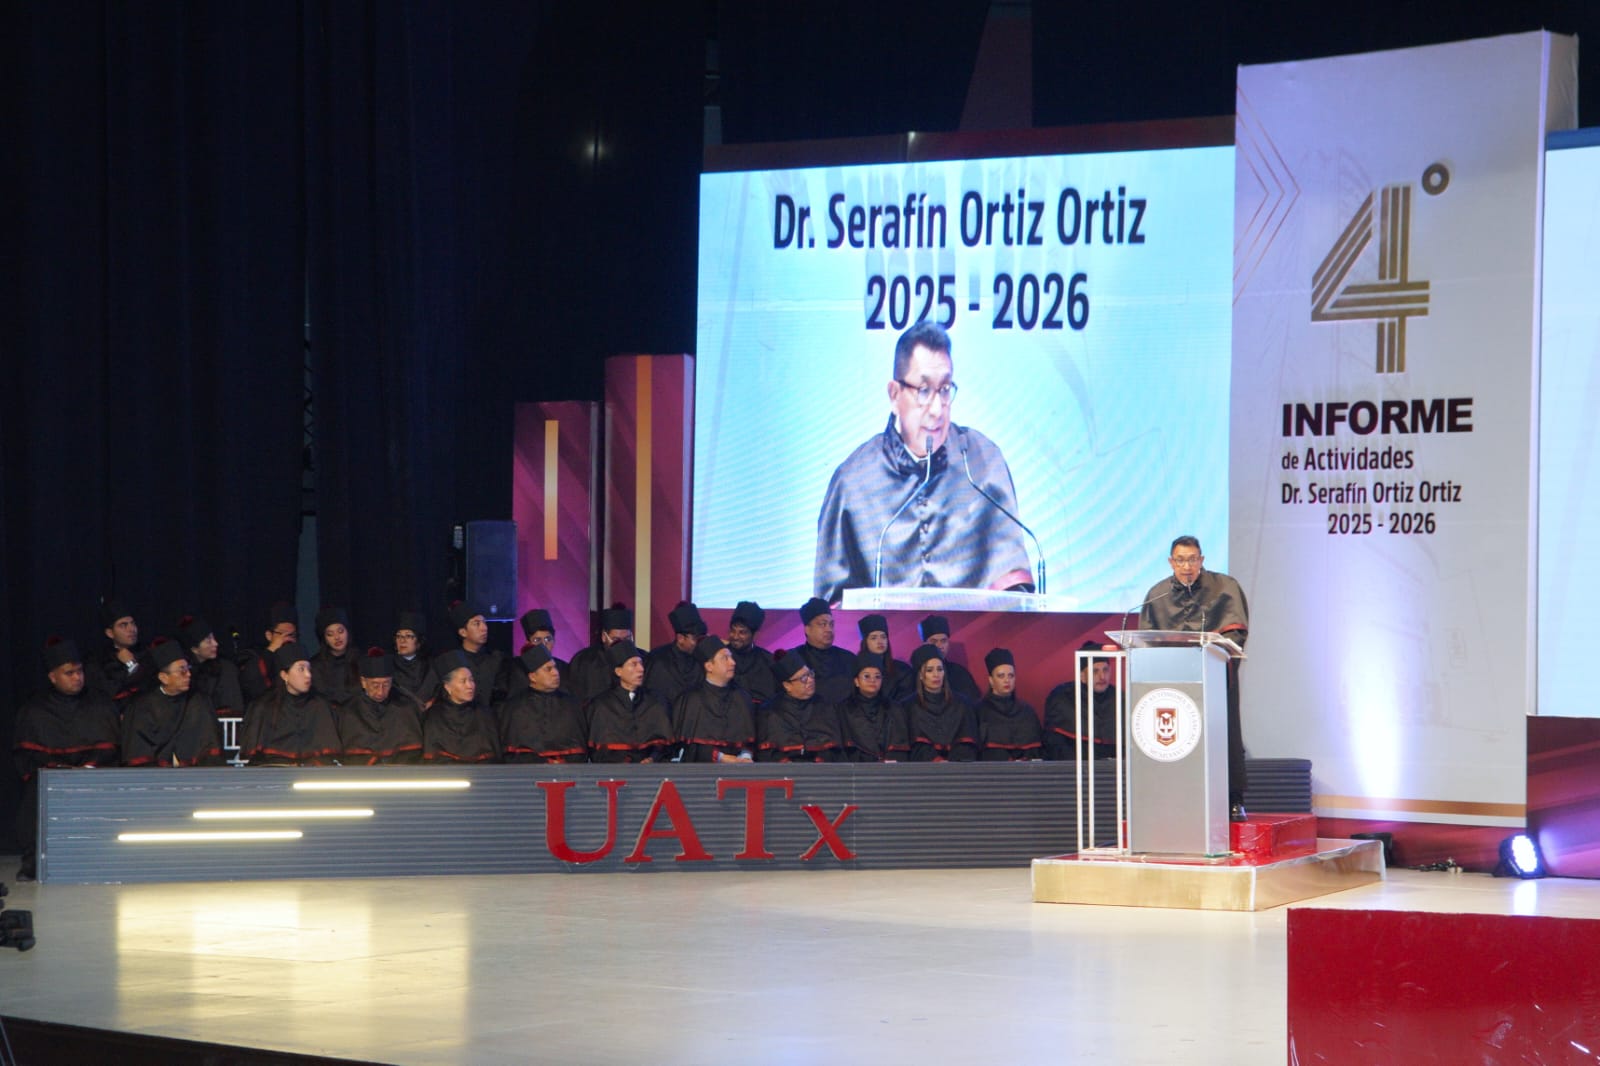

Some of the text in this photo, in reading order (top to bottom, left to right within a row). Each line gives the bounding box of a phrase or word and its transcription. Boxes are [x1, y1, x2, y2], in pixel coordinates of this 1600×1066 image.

[773, 186, 1147, 249] Dr. Serafín Ortiz Ortiz
[865, 274, 956, 330] 2025
[992, 273, 1090, 330] 2026
[1282, 398, 1473, 437] INFORME
[1281, 446, 1414, 471] de Actividades
[1281, 480, 1462, 504] Dr. Serafín Ortiz Ortiz
[1328, 513, 1372, 535] 2025
[1389, 512, 1436, 534] 2026
[535, 777, 860, 864] UATx
